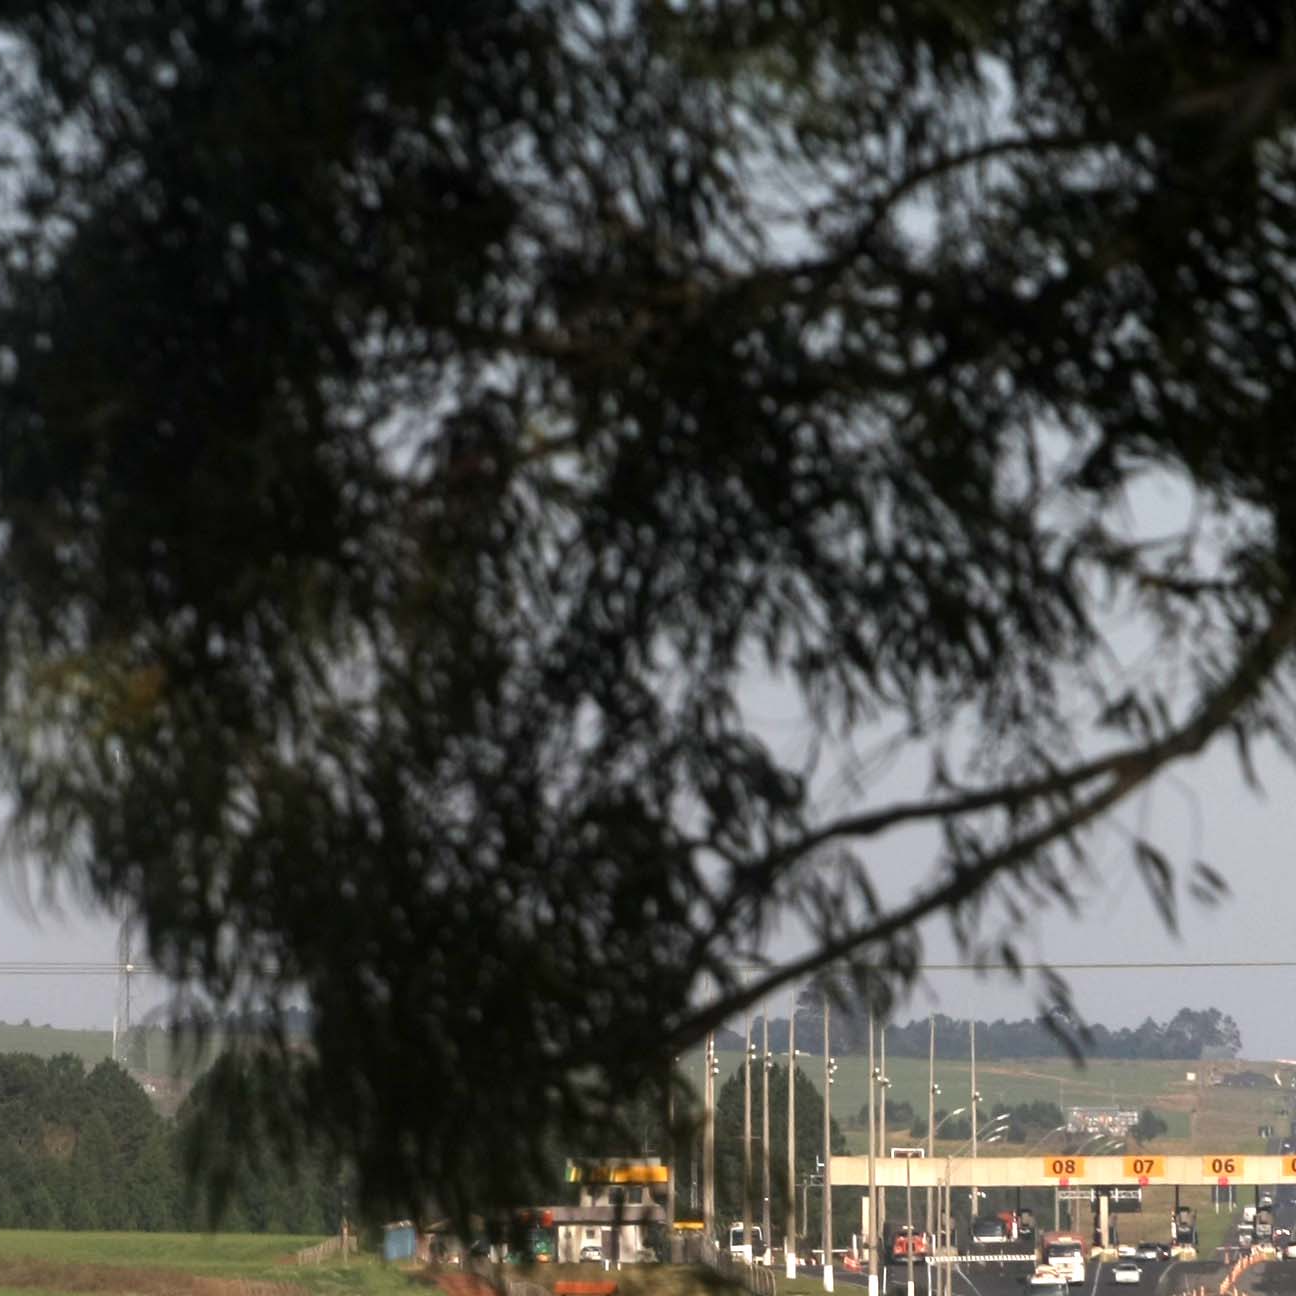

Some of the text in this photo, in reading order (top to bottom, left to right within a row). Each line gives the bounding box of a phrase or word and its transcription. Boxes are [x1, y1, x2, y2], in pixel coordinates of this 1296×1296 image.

[1052, 1159, 1075, 1174] 08
[1133, 1159, 1154, 1174] 07
[1212, 1158, 1235, 1173] 06
